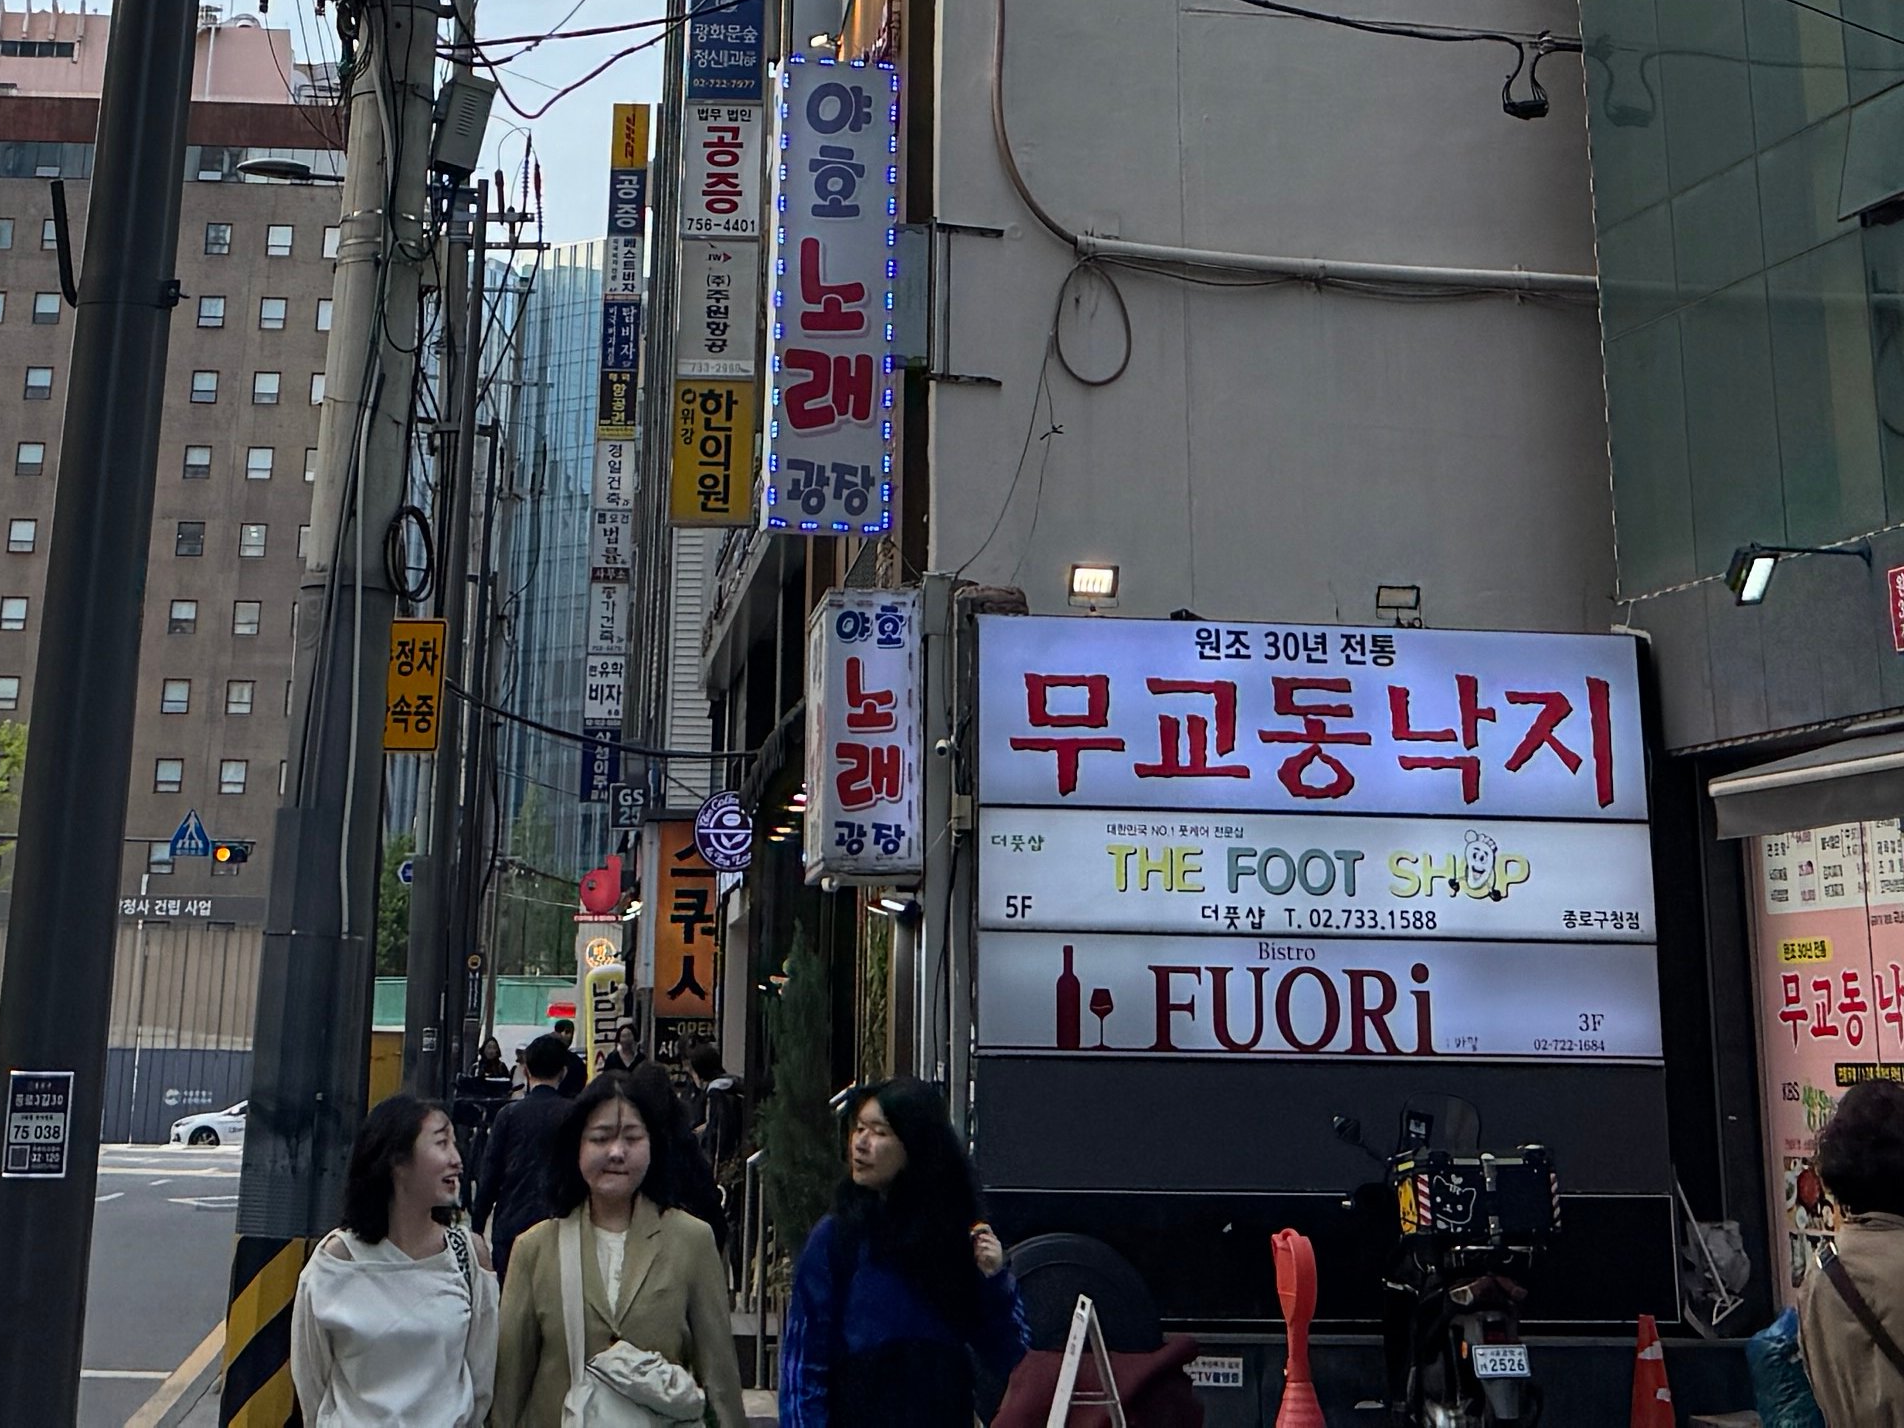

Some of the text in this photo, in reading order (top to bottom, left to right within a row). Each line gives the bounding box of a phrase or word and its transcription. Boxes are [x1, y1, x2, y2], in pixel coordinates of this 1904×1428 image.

[694, 25, 759, 44] 광화문숲
[697, 108, 752, 123] 법무 법인
[805, 81, 874, 220] 야호
[702, 126, 744, 215] 공증
[614, 175, 640, 228] 공증
[687, 218, 756, 232] 756-4401
[783, 237, 875, 432] 노래
[697, 389, 739, 514] 한의원
[786, 459, 877, 517] 광장
[836, 605, 905, 648] 야호
[388, 637, 439, 678] 정차
[1195, 627, 1398, 667] 원조 30년 전통
[588, 684, 622, 705] 비자
[383, 693, 435, 734] 속중
[835, 656, 903, 811] 노래
[1009, 672, 1616, 809] 무교동낙지
[619, 789, 644, 805] GS
[834, 820, 906, 856] 광장
[991, 834, 1045, 853] 더풋샵
[1106, 843, 1205, 893] THE
[1227, 847, 1364, 897] FOOT
[118, 898, 212, 917] 청사 건립 사업
[1005, 895, 1033, 919] 5F
[1201, 904, 1266, 931] 더풋샵
[1309, 907, 1438, 931] 02.733.1588
[1562, 910, 1640, 930] 종로구청점
[1257, 941, 1317, 962] Bistro
[1147, 963, 1438, 1056] FUORi
[1578, 1013, 1605, 1032] 3F
[14, 1125, 61, 1140] 75 038
[1489, 1358, 1526, 1372] 2526
